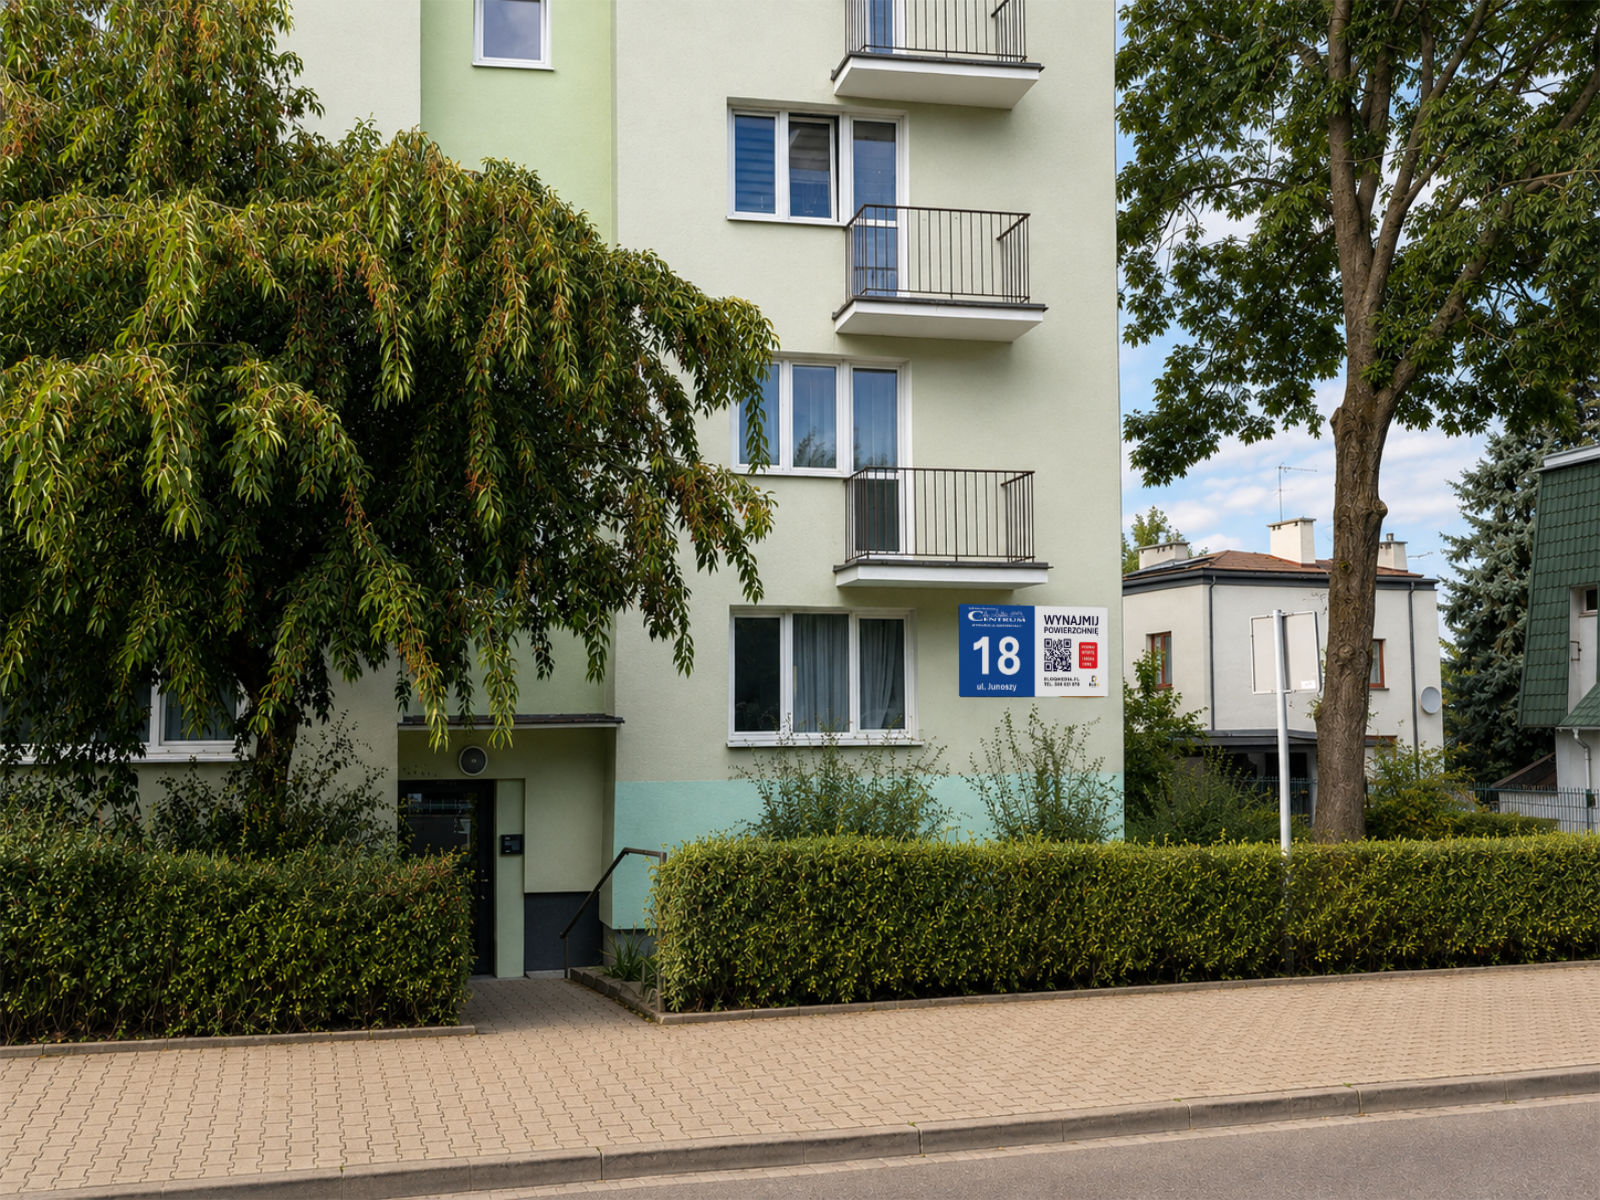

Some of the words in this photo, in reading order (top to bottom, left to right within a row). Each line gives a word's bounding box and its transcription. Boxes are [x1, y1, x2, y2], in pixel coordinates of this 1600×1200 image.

[968, 610, 1026, 622] CENTRUM
[1043, 614, 1099, 626] WYNAJMIJ
[1043, 626, 1099, 636] POWIERZCHNIĘ
[973, 636, 1021, 675] 18
[976, 682, 986, 691] ul.
[987, 682, 1017, 692] Junoszy
